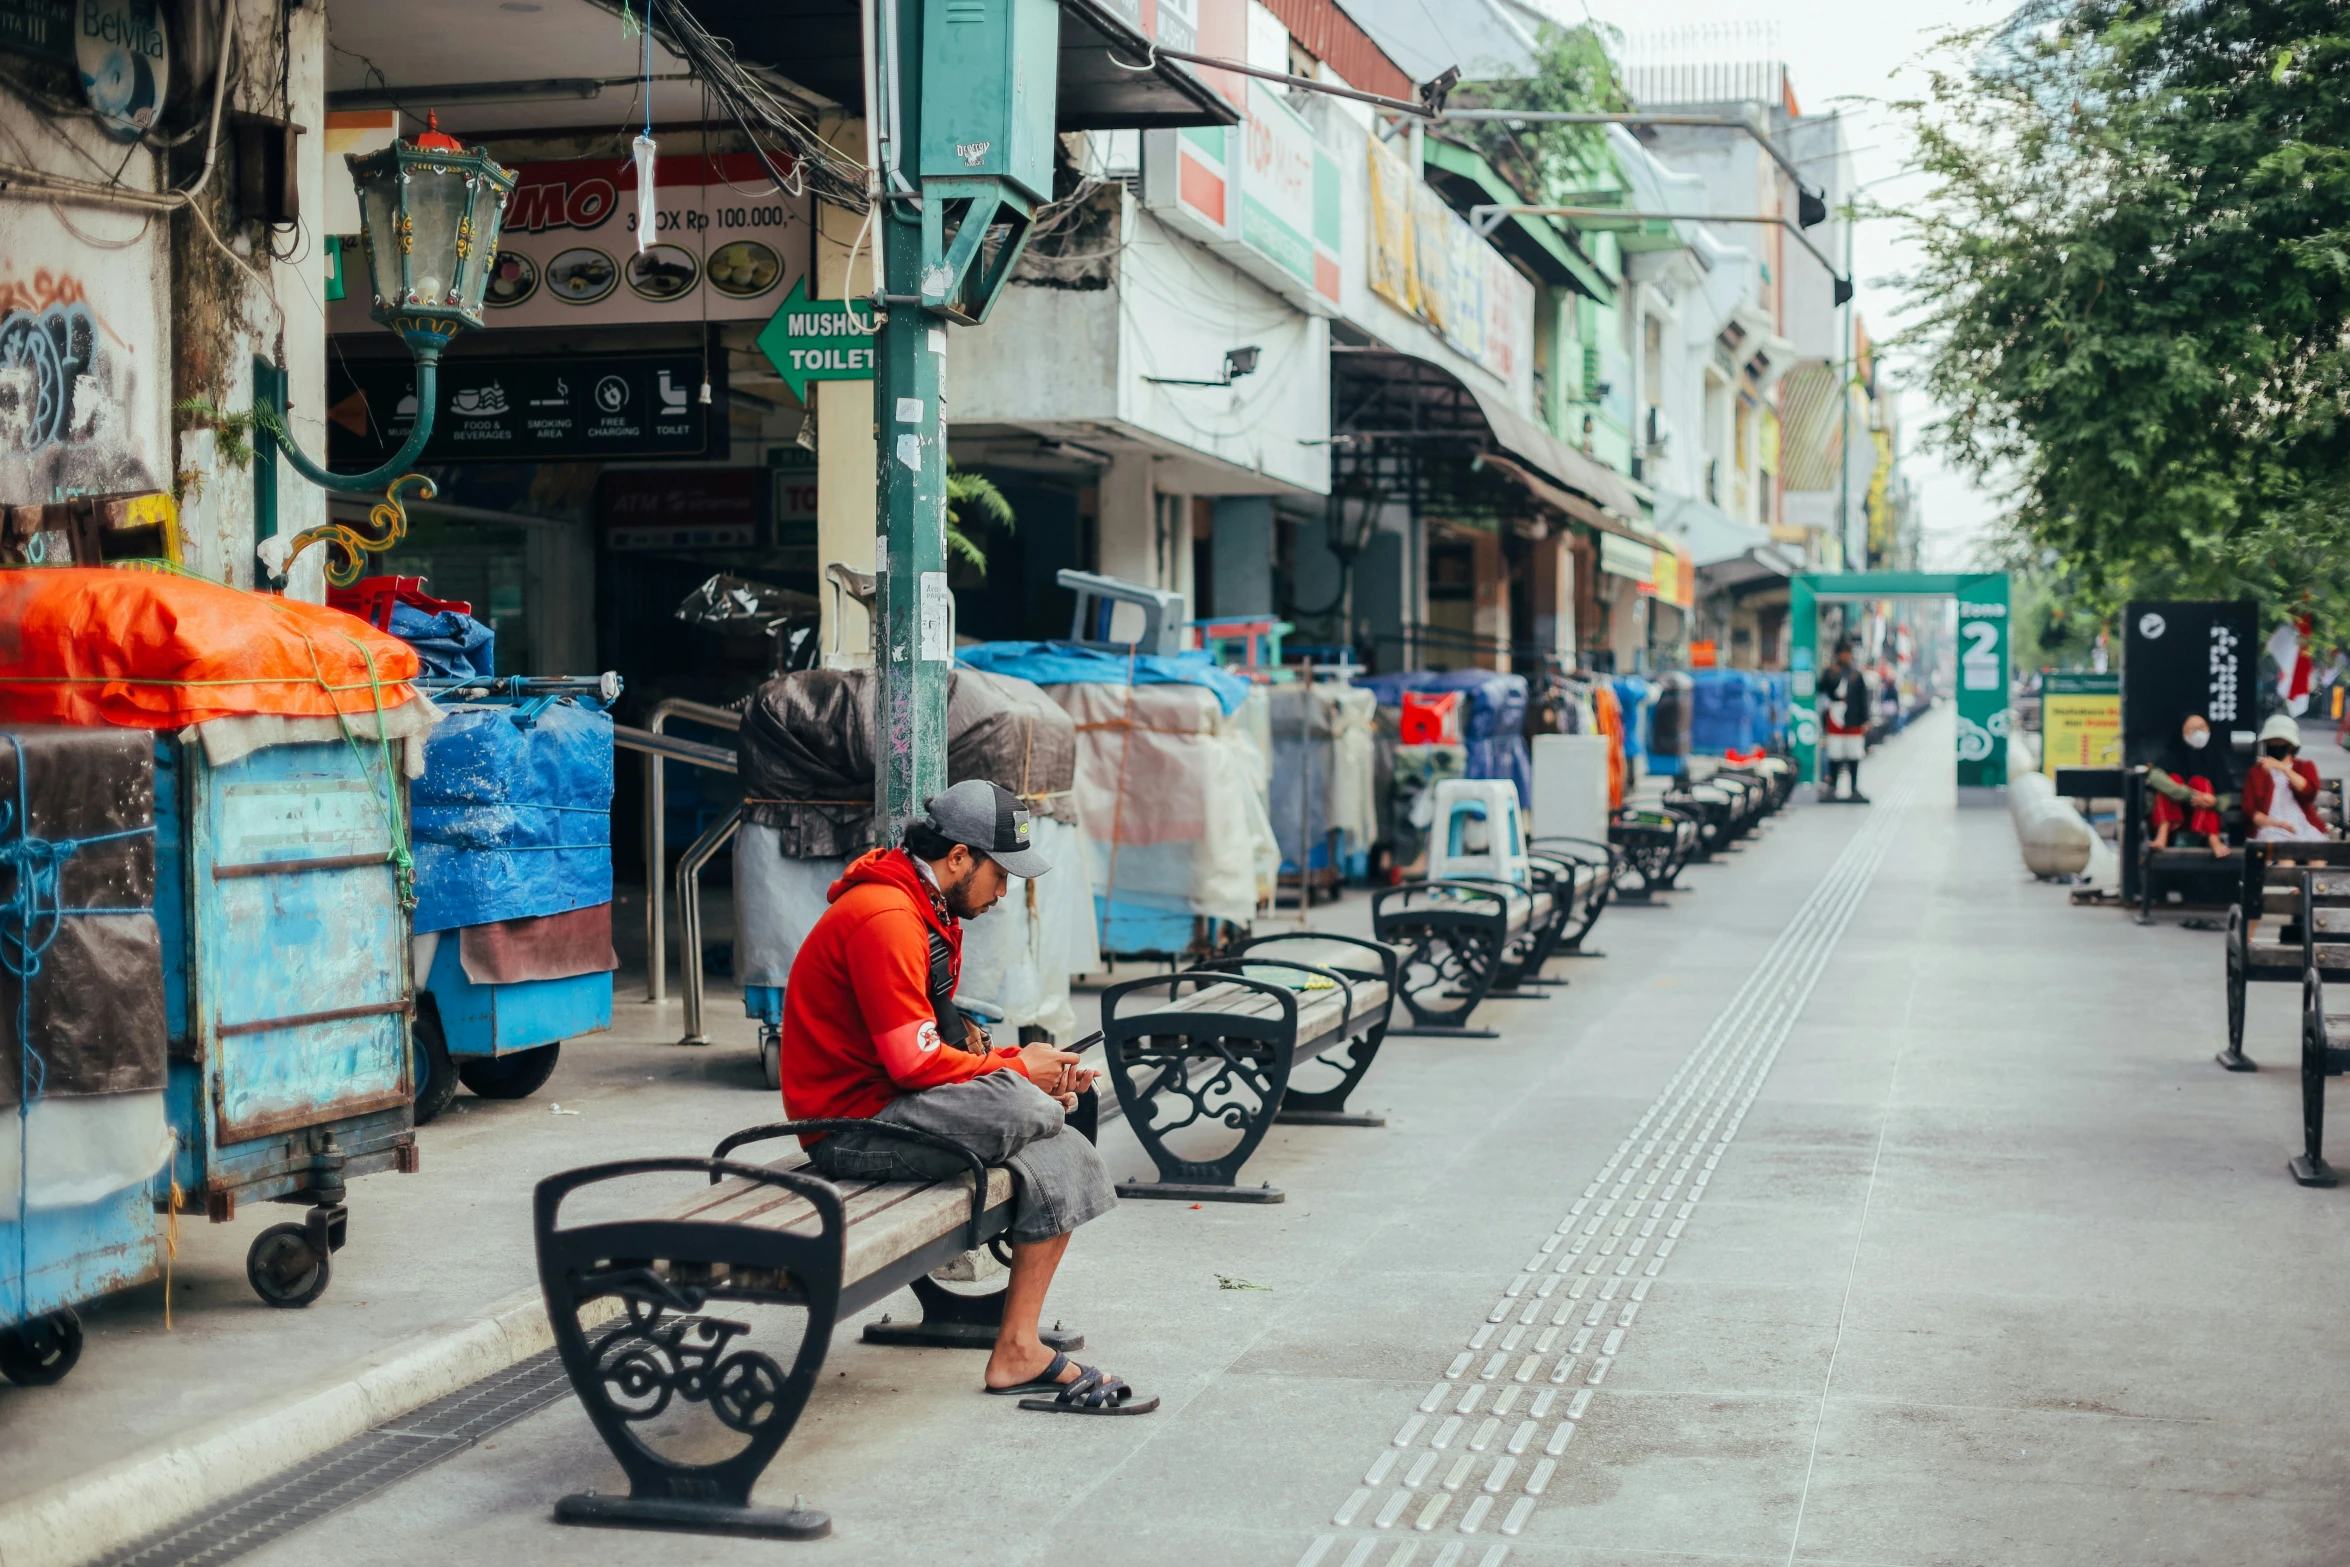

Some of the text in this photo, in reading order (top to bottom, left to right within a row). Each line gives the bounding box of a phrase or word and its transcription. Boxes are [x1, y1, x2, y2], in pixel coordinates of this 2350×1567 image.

[83, 2, 164, 60] Belvita
[501, 178, 618, 234] MO
[626, 215, 637, 232] 3
[686, 209, 709, 233] Rp
[464, 421, 500, 430] FOOD &
[527, 419, 572, 429] SMOKING
[601, 417, 626, 427] FREE
[537, 429, 563, 438] AREA
[588, 428, 640, 437] CHARGING
[656, 425, 690, 435] TOILET
[453, 431, 512, 440] BEVERAGES
[1961, 621, 1999, 664] 2
